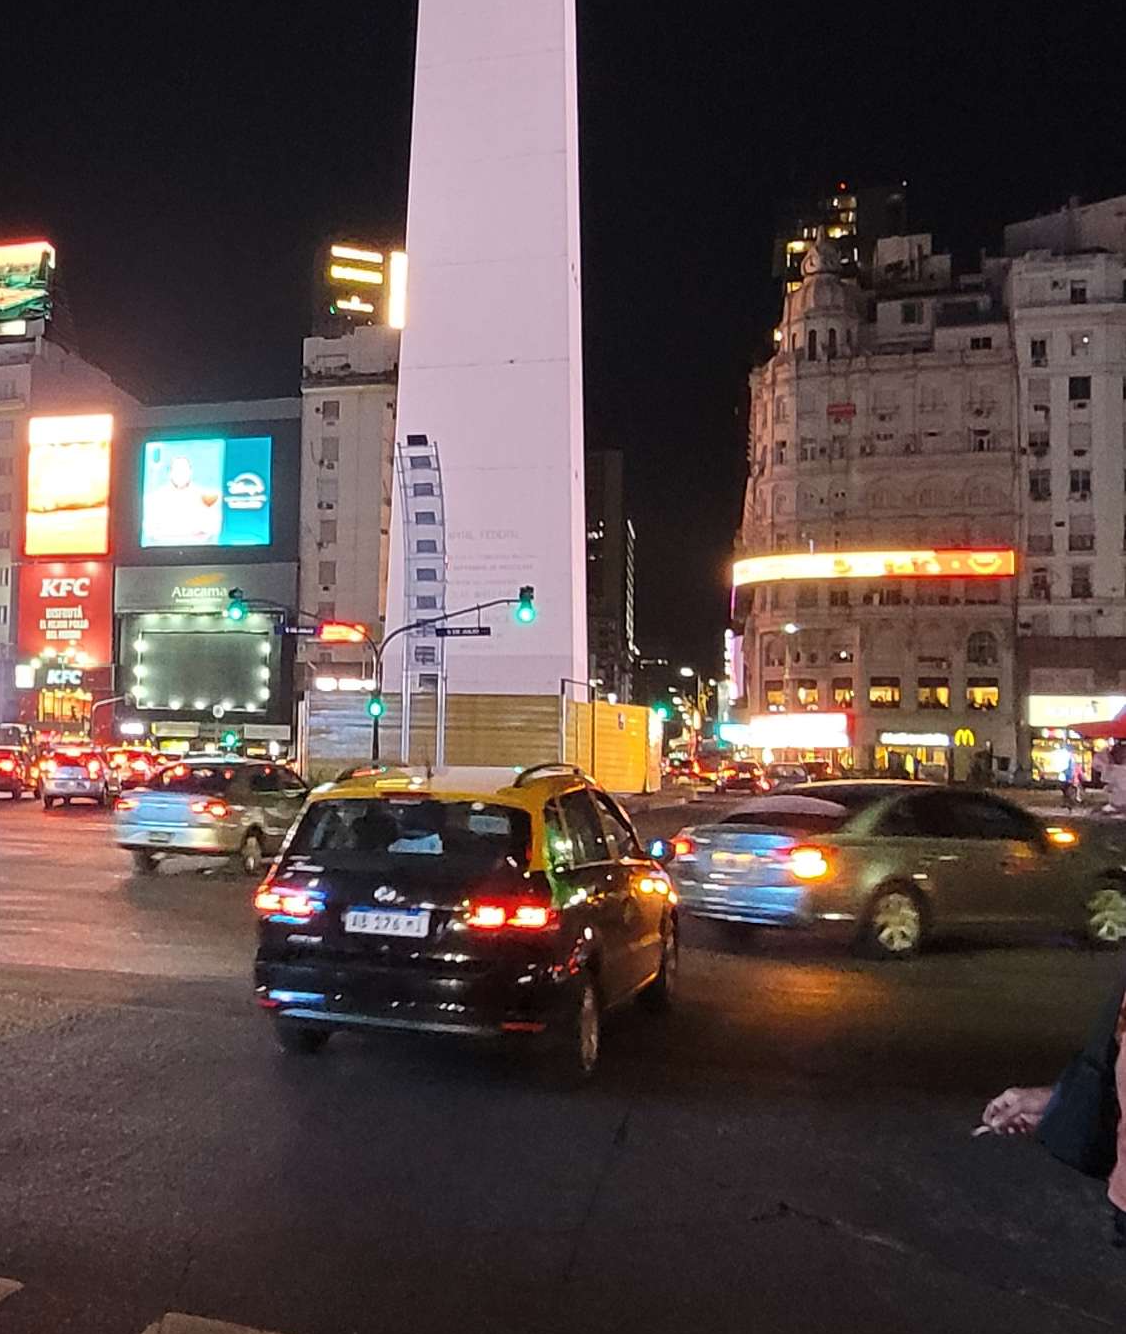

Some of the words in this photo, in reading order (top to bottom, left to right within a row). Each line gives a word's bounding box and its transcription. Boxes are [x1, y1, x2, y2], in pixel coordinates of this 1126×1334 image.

[39, 577, 91, 598] KFC
[171, 586, 228, 598] Atacama
[46, 669, 84, 685] KFC
